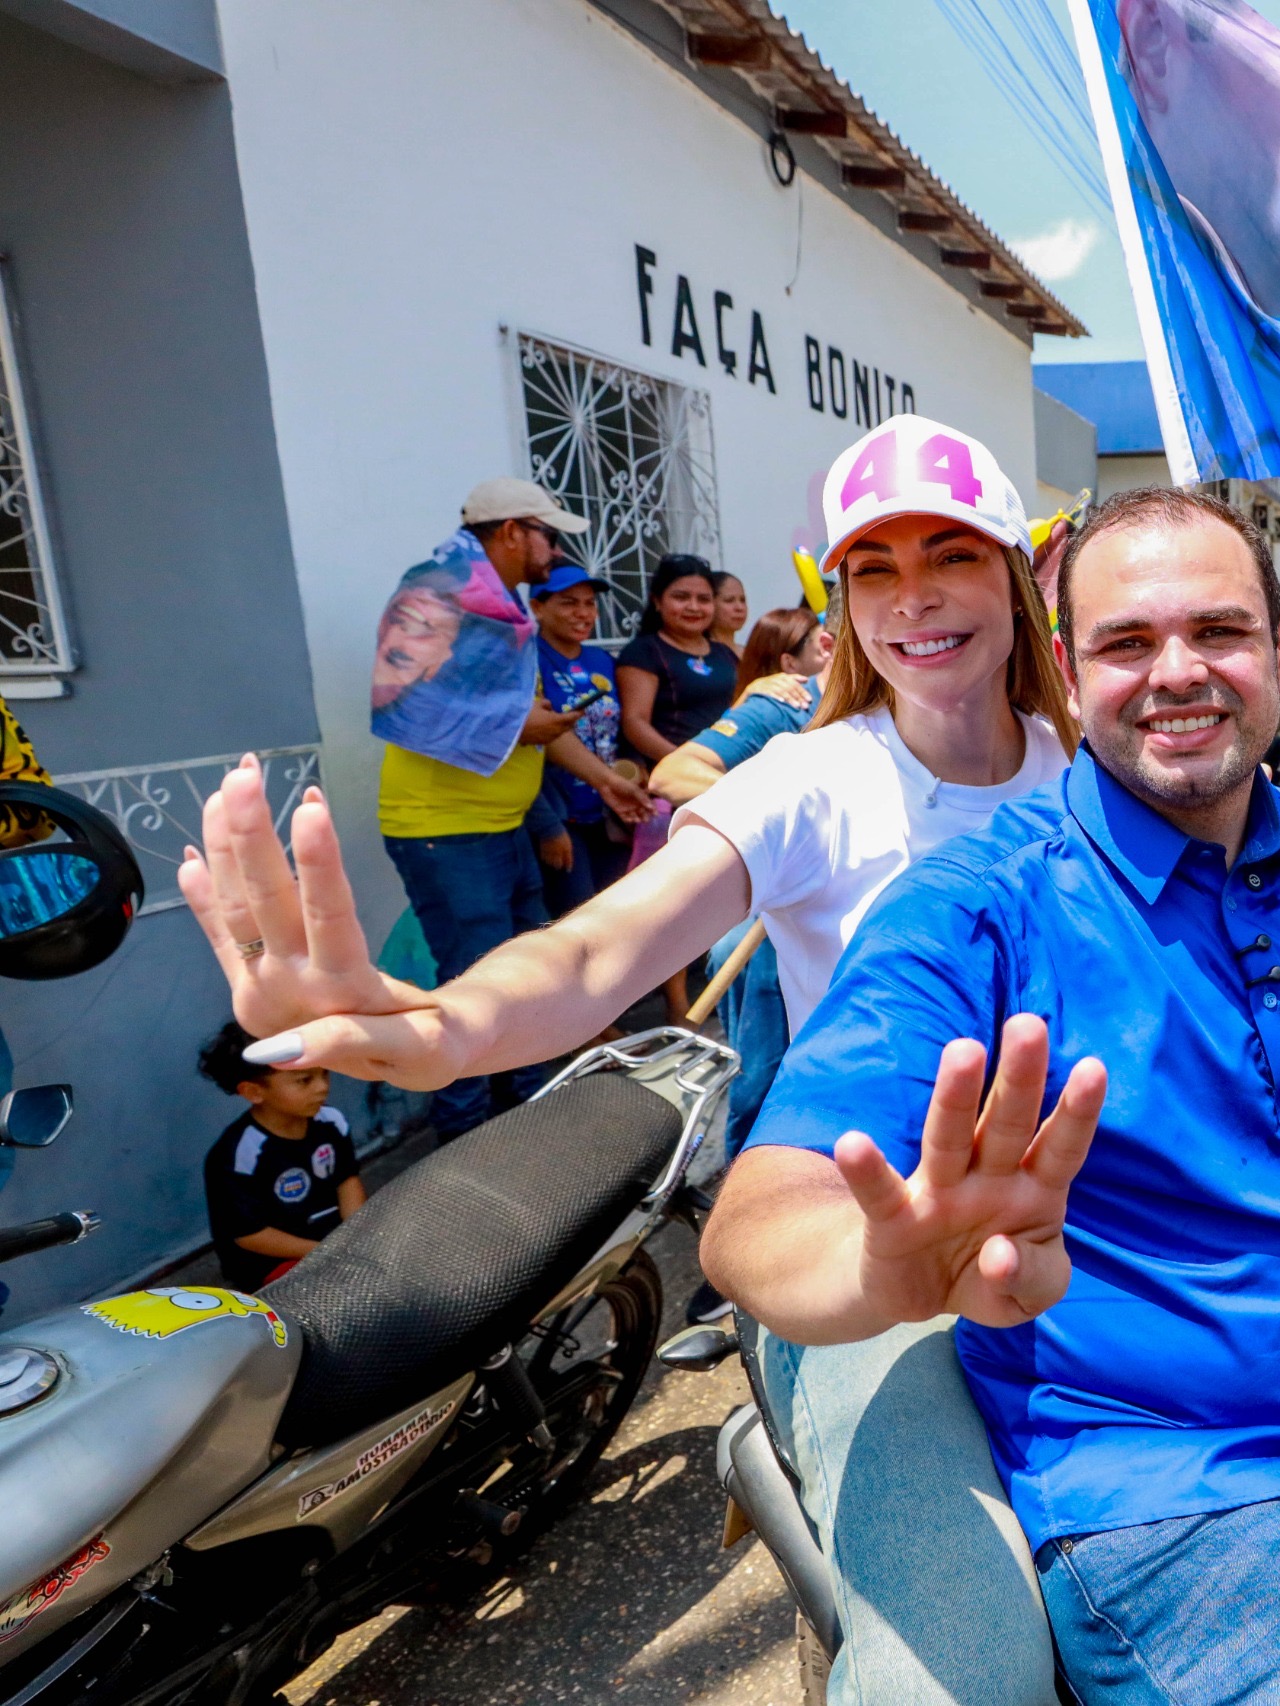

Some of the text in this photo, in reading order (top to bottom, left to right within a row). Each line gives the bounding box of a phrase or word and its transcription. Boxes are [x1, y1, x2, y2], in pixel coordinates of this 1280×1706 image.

[634, 242, 916, 430] FAÇA BONITO
[841, 429, 983, 513] 44
